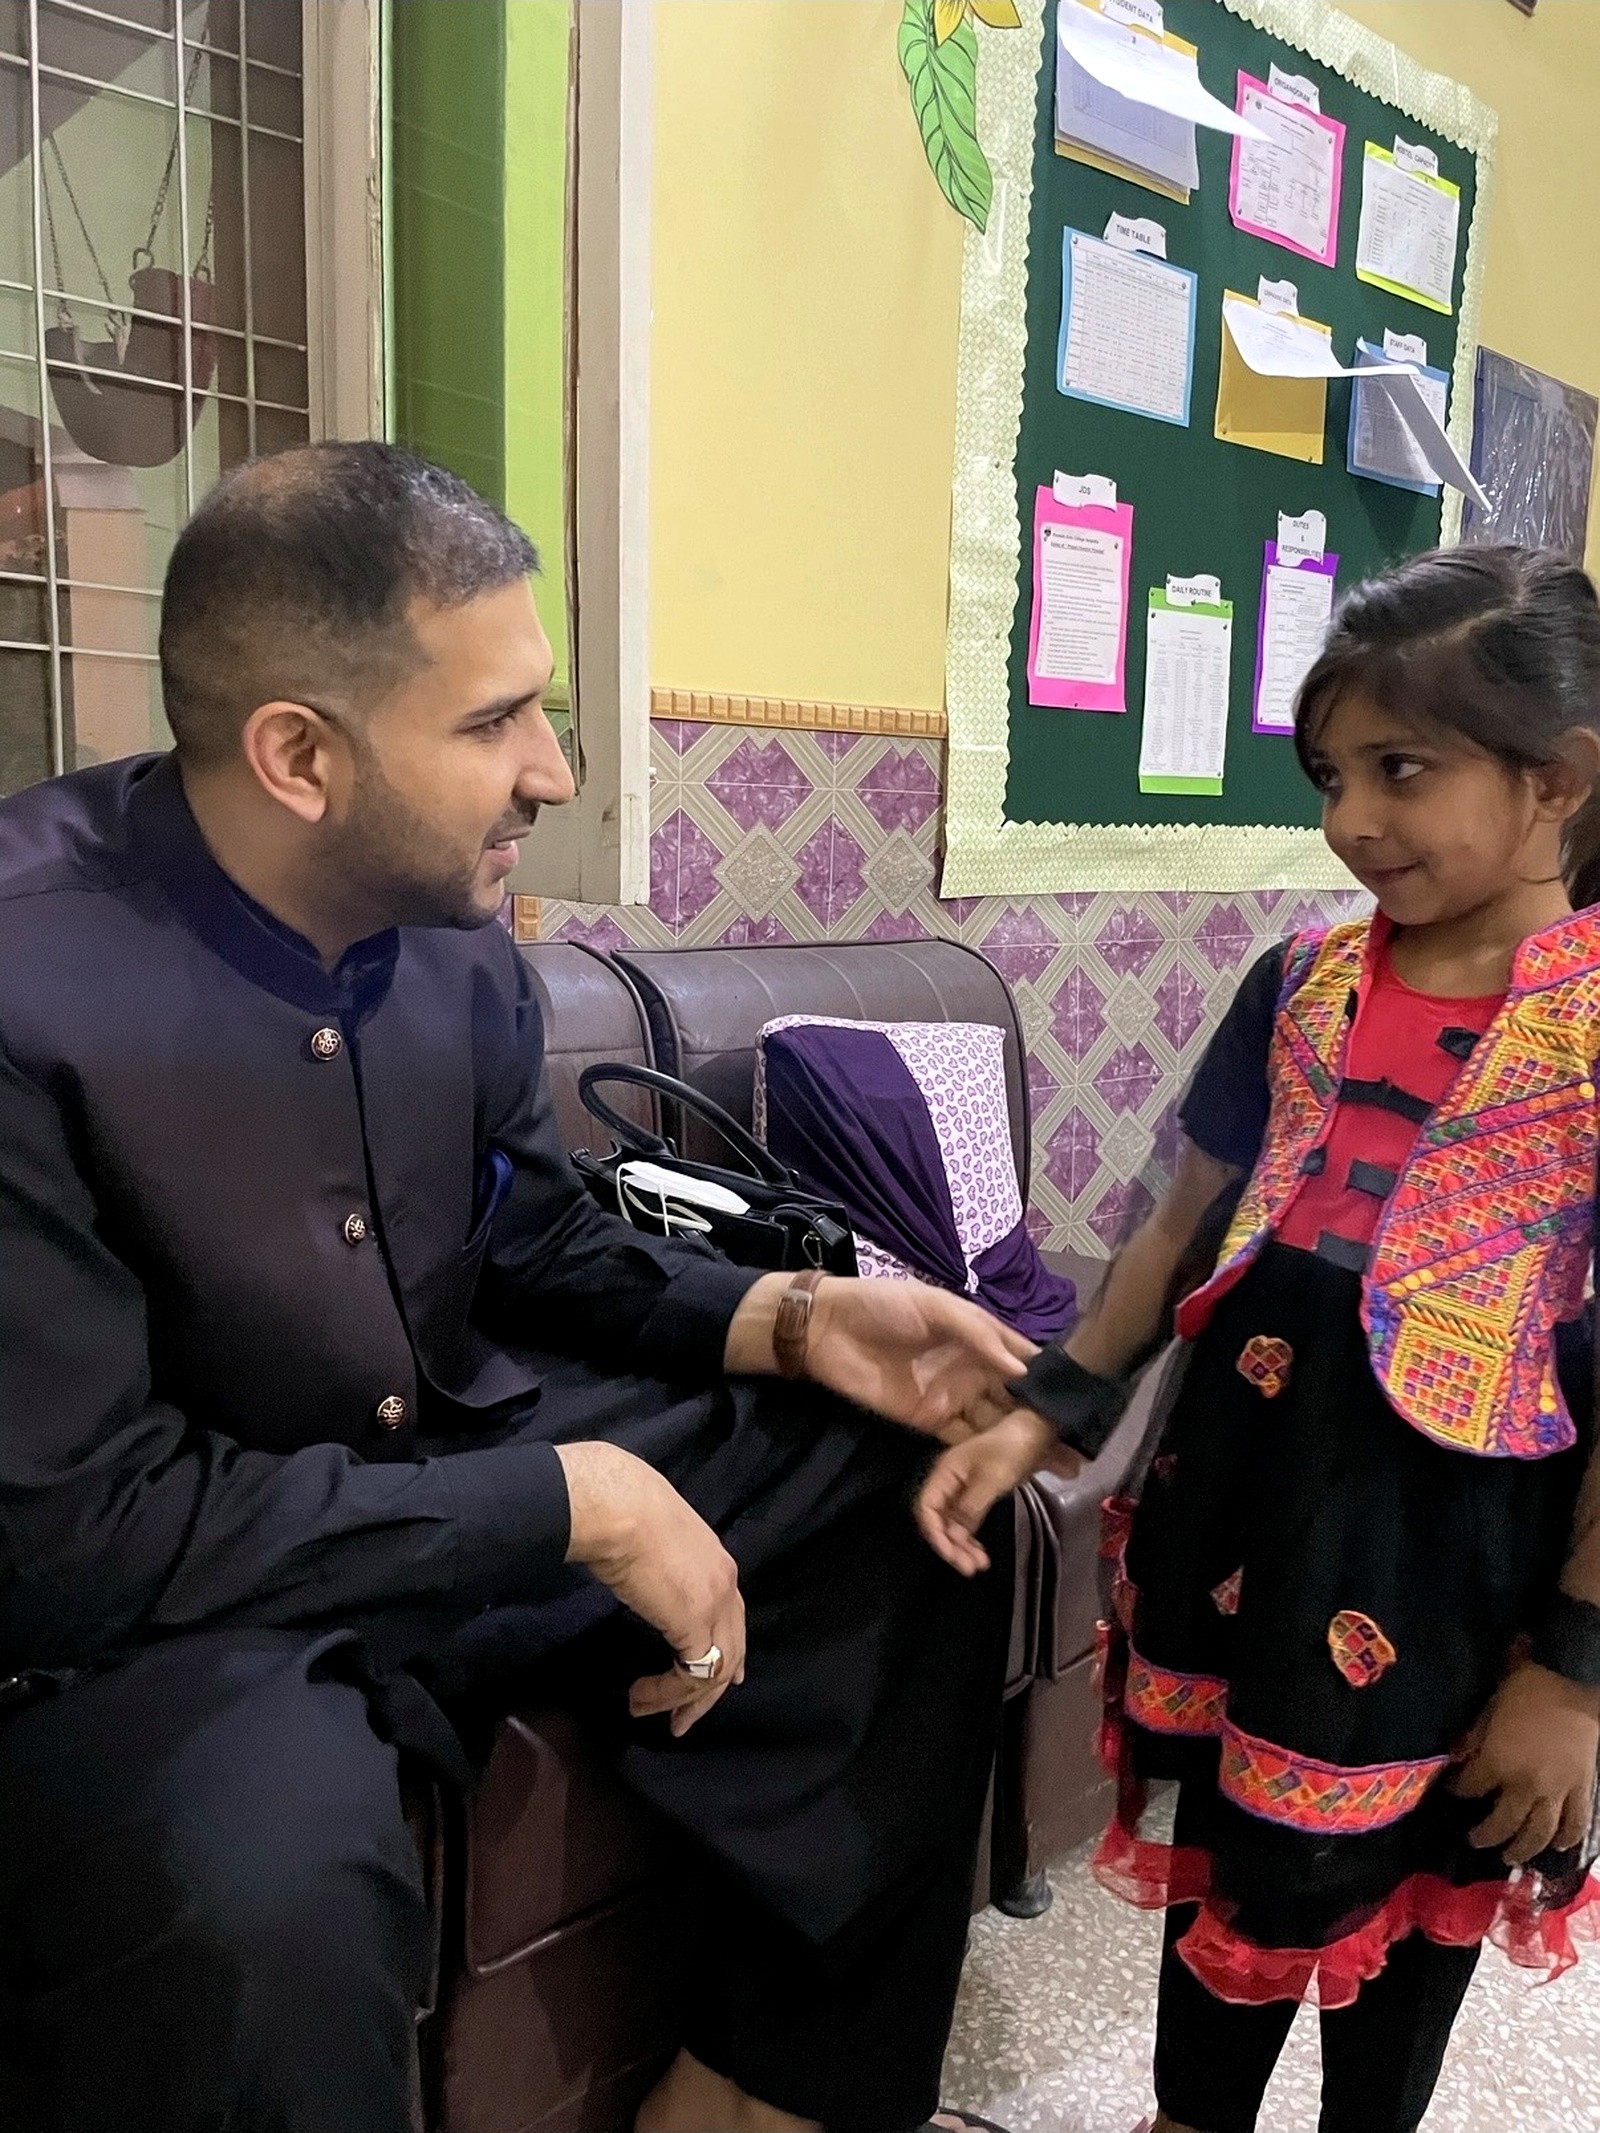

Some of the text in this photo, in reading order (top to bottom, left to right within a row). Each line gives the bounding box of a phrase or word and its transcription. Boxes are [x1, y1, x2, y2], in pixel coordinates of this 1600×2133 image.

[1109, 0, 1154, 23] UDENT DATA
[1116, 224, 1151, 245] TIME TABLE
[1390, 338, 1415, 354] STAFF DATA
[1171, 585, 1211, 598] DAILY ROUTINE
